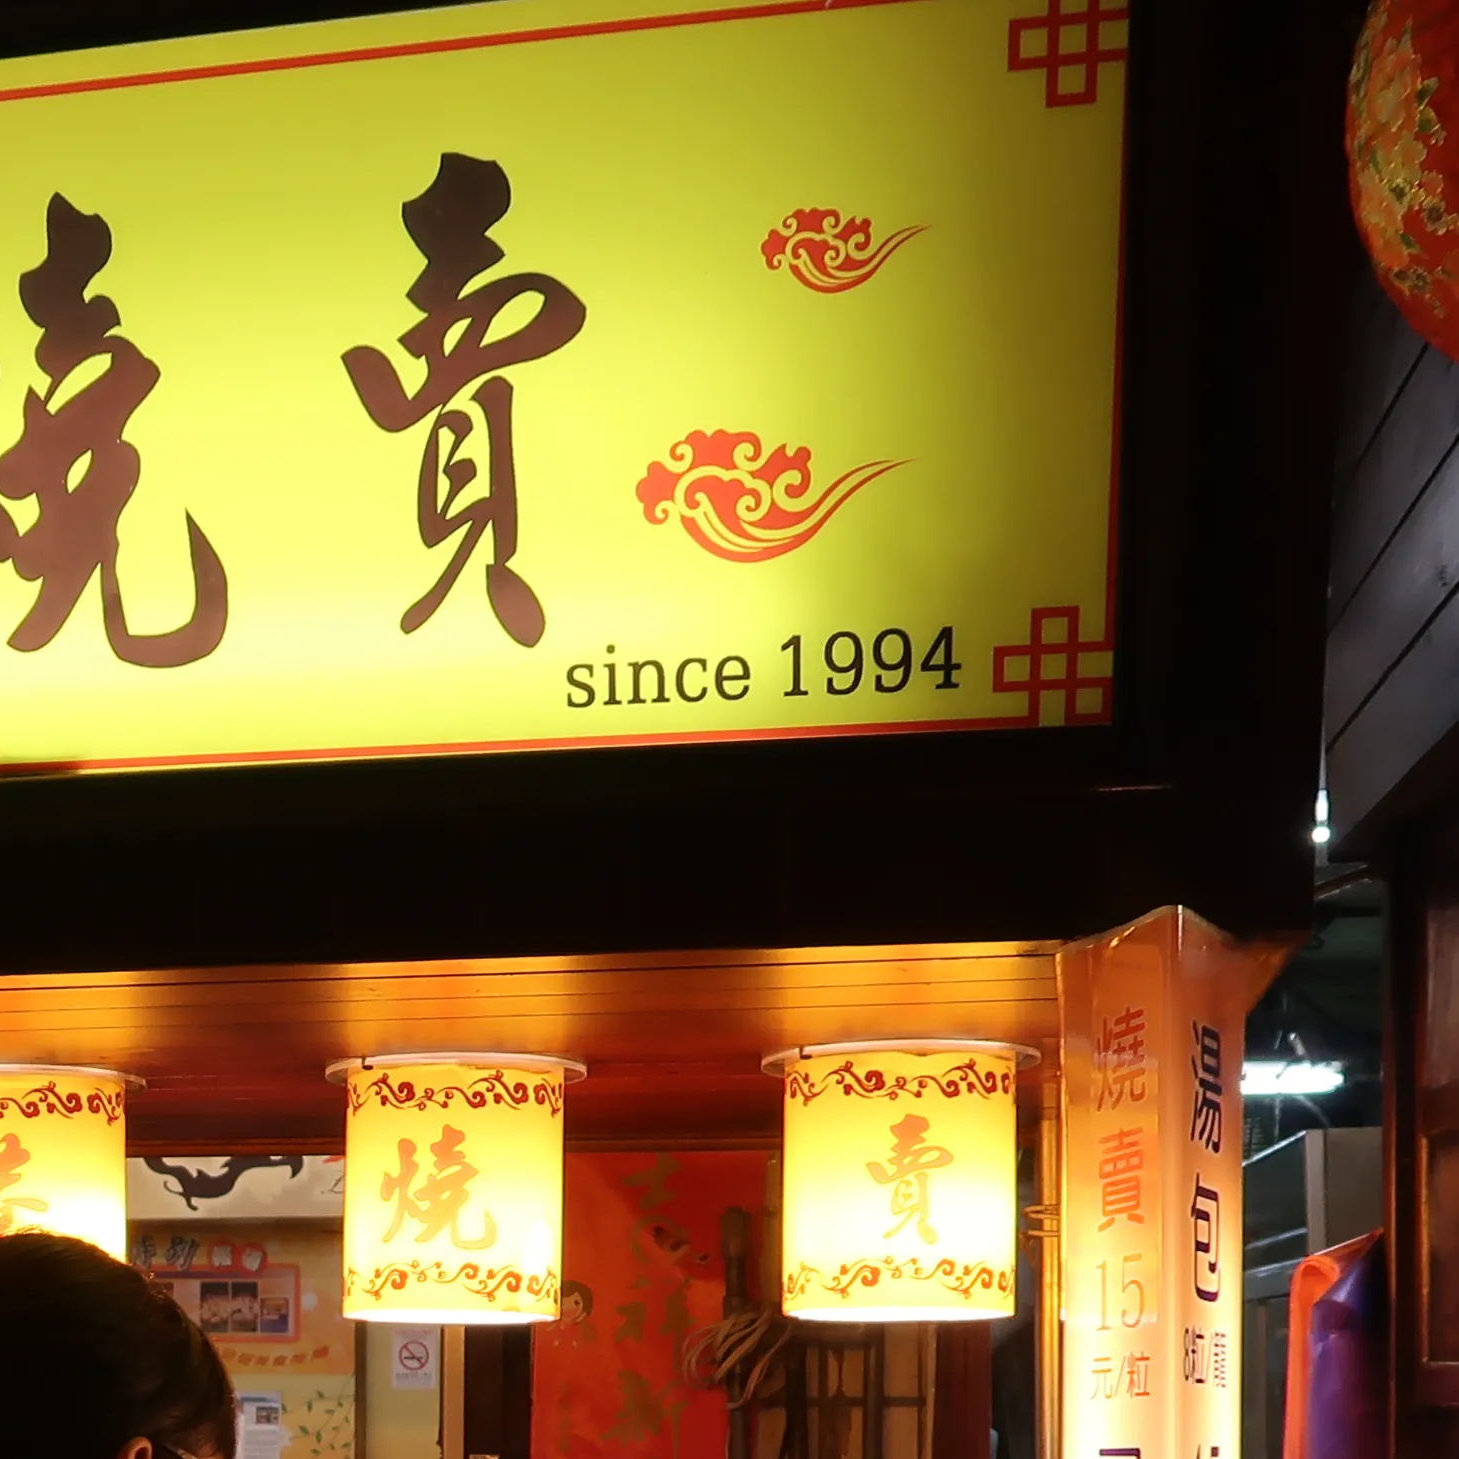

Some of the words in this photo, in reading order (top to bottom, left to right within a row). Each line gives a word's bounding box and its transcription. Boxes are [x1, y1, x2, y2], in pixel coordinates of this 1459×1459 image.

[565, 643, 752, 709] since
[779, 625, 963, 699] 1994
[866, 1114, 954, 1244] 賣
[1096, 1006, 1146, 1233] 燒賣
[1191, 1020, 1223, 1303] 湯包
[381, 1124, 498, 1250] 燒
[1095, 1253, 1145, 1331] 15
